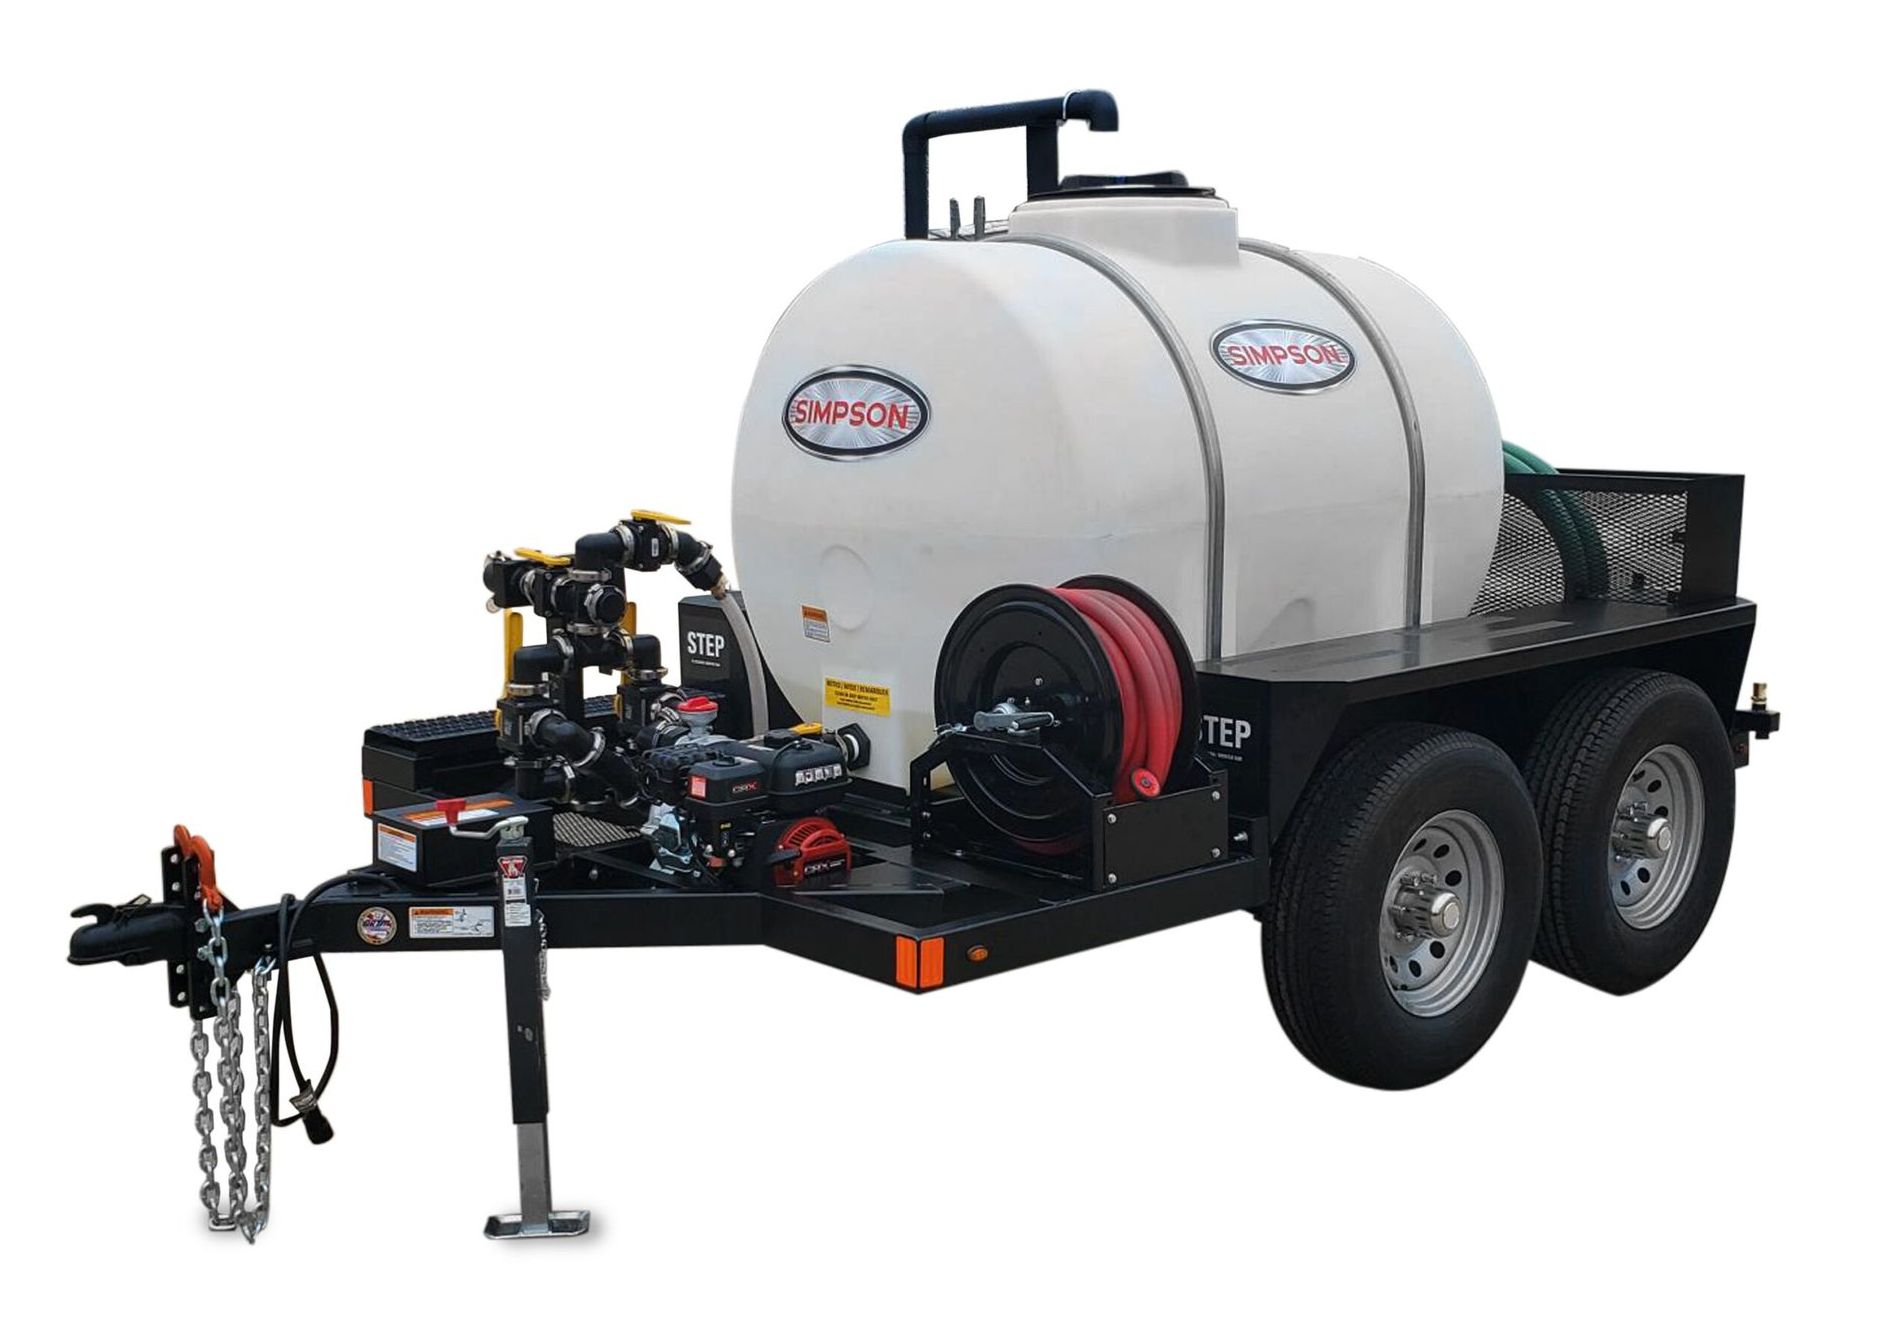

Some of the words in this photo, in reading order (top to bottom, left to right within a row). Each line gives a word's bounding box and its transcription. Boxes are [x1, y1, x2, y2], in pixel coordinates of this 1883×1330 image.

[1227, 343, 1346, 366] SIMPSON
[794, 399, 909, 430] SIMPSON
[687, 631, 725, 658] STEP
[1199, 714, 1252, 749] TEP
